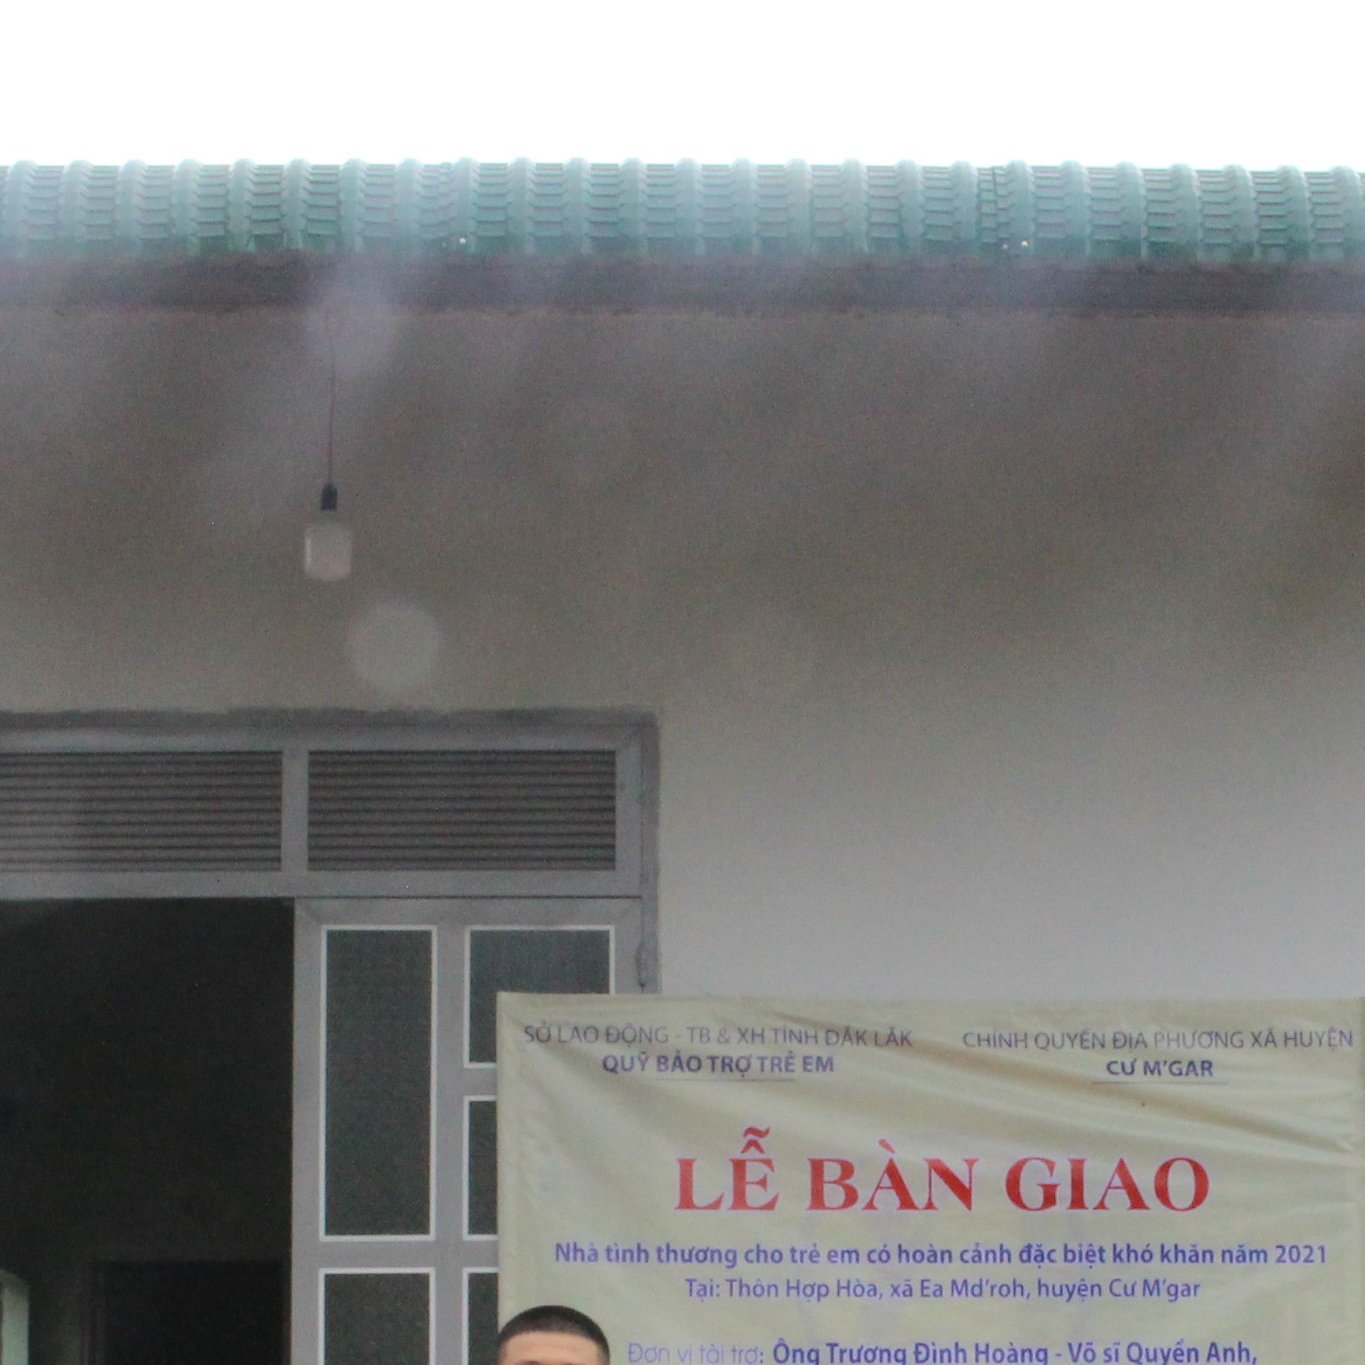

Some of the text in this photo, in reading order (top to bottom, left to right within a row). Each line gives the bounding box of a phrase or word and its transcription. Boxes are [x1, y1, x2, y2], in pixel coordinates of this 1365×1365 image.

[524, 1023, 551, 1044] SỞ
[557, 1027, 599, 1044] LAO
[605, 1023, 669, 1048] ĐỘNG
[686, 1027, 711, 1044] TB
[717, 1027, 731, 1045] &
[737, 1028, 765, 1045] XH
[963, 1028, 1029, 1049] CHÍNH
[1113, 1030, 1148, 1053] ĐỊA
[1154, 1029, 1244, 1049] PHƯƠNG
[1251, 1027, 1278, 1048] XÃ
[1284, 1027, 1354, 1051] HUYỆN
[602, 1050, 836, 1078] QUỸ BẢO TRỢ TRẺ EM
[1106, 1058, 1138, 1077] CƯ
[674, 1126, 1211, 1212] LỄ BÀN GIAO
[554, 1241, 1328, 1269] Nhà tình thương cho trẻ em có hoàn cảnh đặc biệt khó khăn năm 2021
[685, 1278, 721, 1302] Tại:
[725, 1278, 779, 1299] Thôn
[785, 1279, 830, 1302] Hợp
[836, 1279, 883, 1301] Hòa,
[889, 1279, 913, 1299] xã
[920, 1279, 945, 1299] Ea
[1037, 1278, 1103, 1303] huyện
[1108, 1278, 1137, 1299] Cư
[627, 1342, 670, 1365] Đơn
[699, 1342, 724, 1365] tài
[913, 1341, 967, 1365] Đình
[1067, 1342, 1097, 1365] Võ
[1102, 1341, 1121, 1365] sĩ
